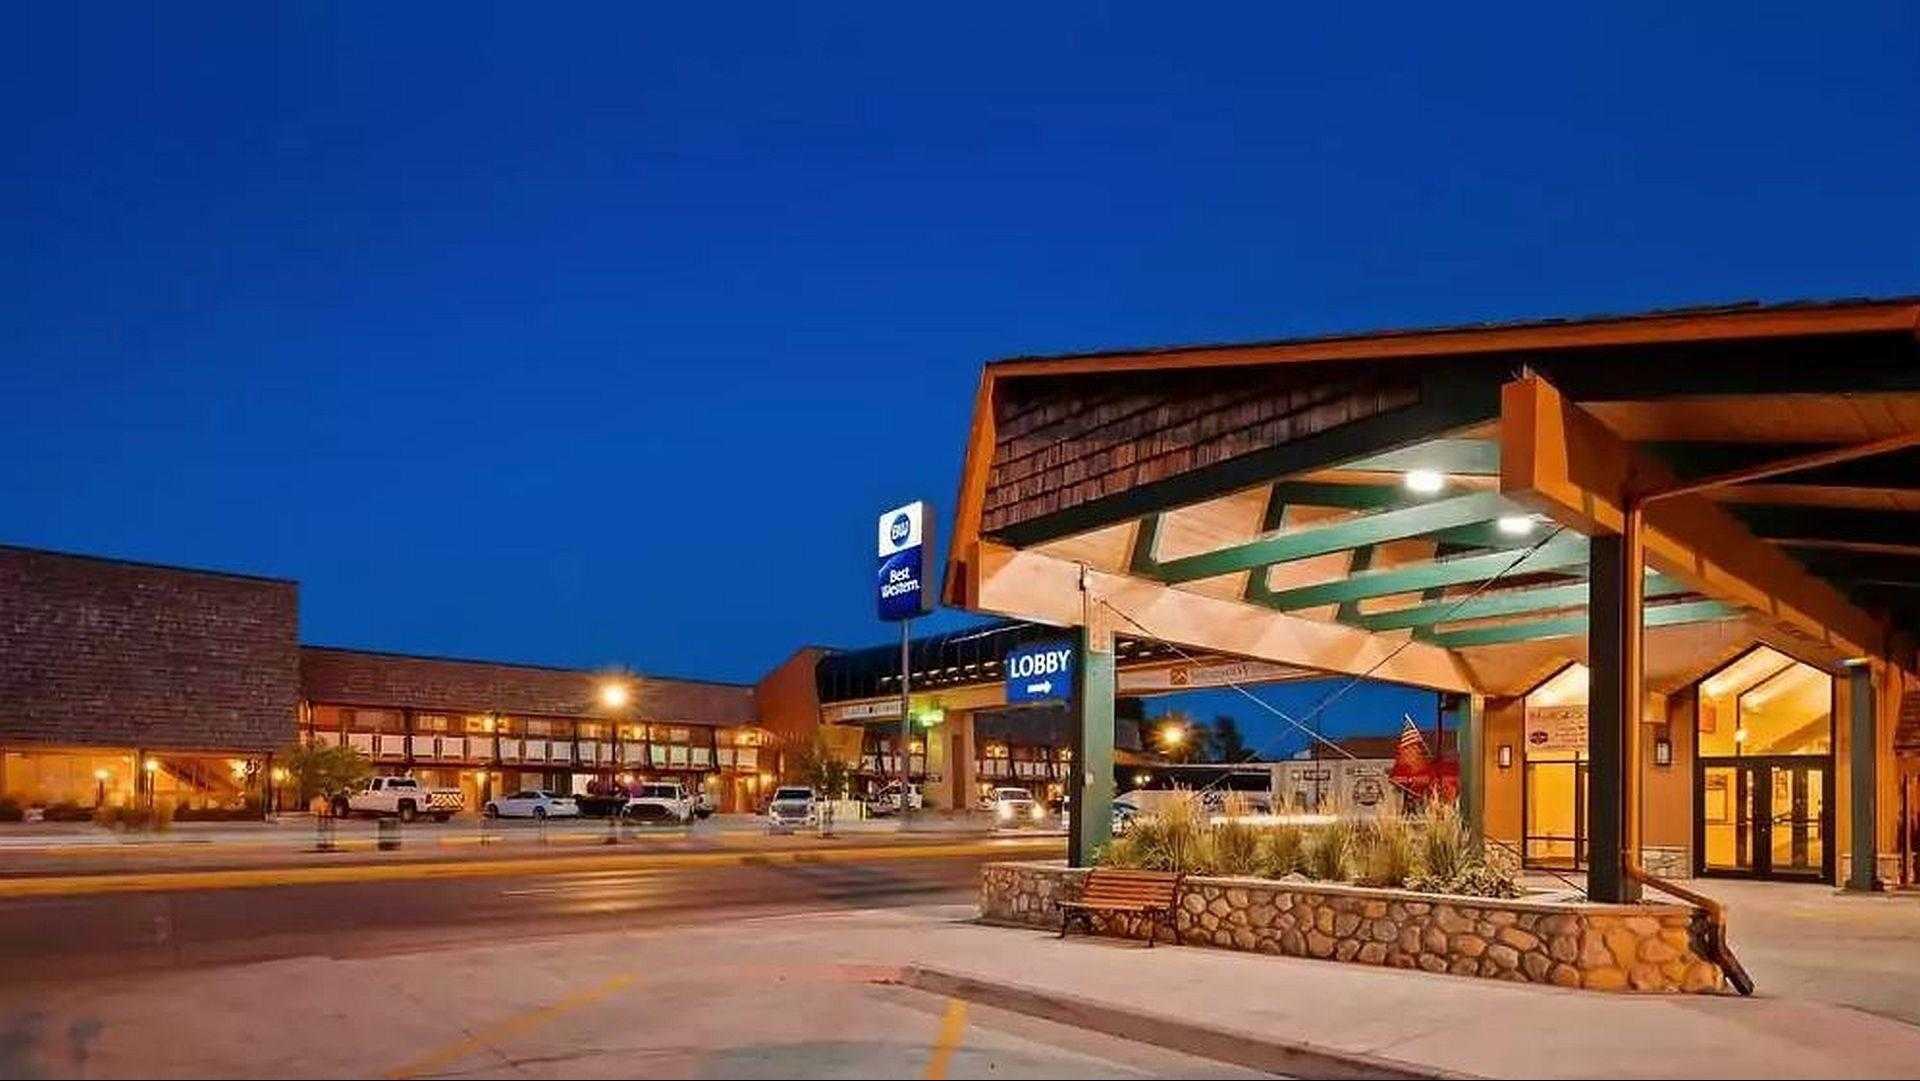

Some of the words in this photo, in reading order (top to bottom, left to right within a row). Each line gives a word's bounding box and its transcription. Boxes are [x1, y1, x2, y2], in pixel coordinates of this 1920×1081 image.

[892, 520, 909, 540] BW
[890, 567, 910, 583] Best
[1011, 649, 1071, 678] LOBBY
